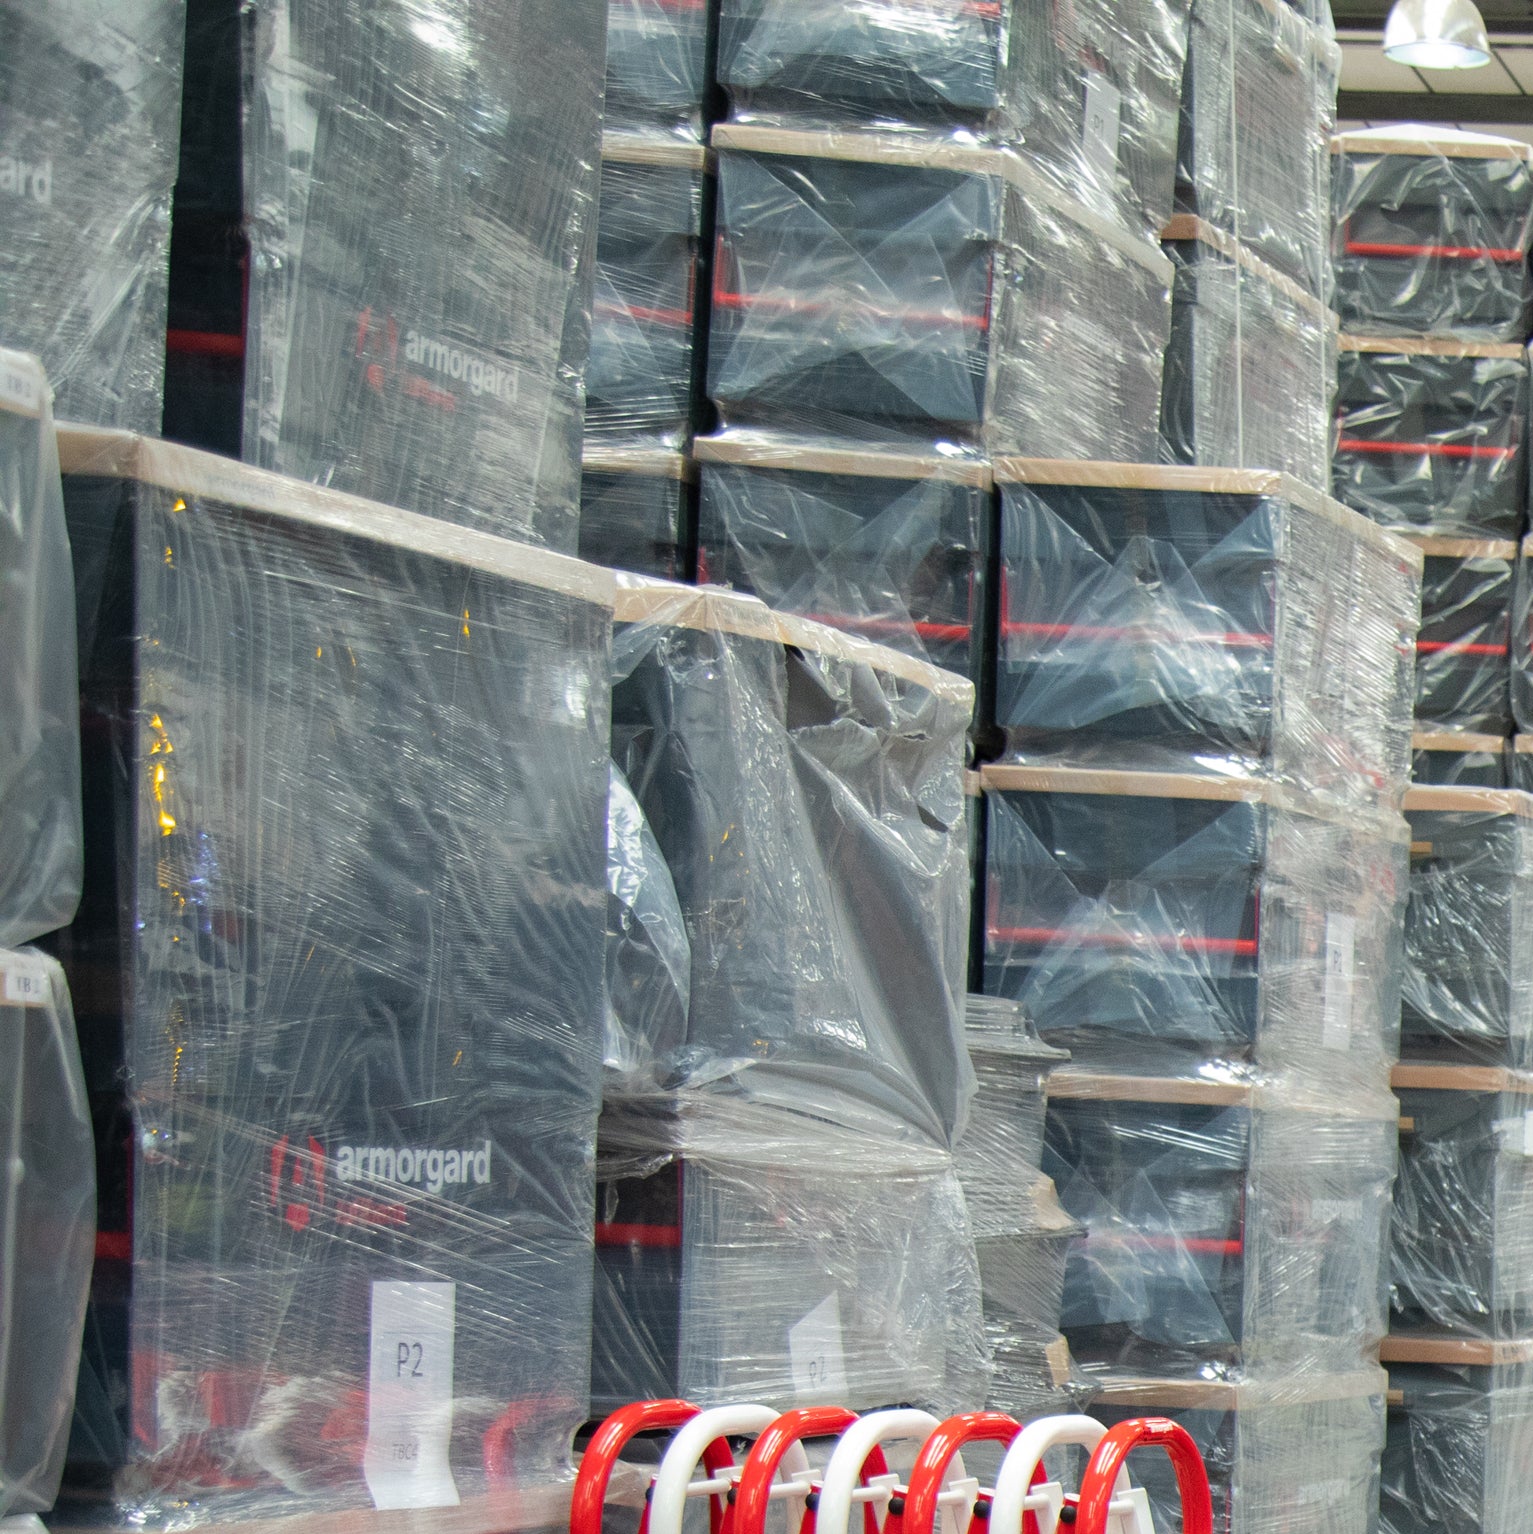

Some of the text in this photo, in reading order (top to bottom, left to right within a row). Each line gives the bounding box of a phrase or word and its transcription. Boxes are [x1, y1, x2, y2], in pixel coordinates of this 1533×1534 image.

[405, 329, 520, 404] armorgard
[337, 1140, 491, 1194] armorgard
[397, 1342, 423, 1377] P2
